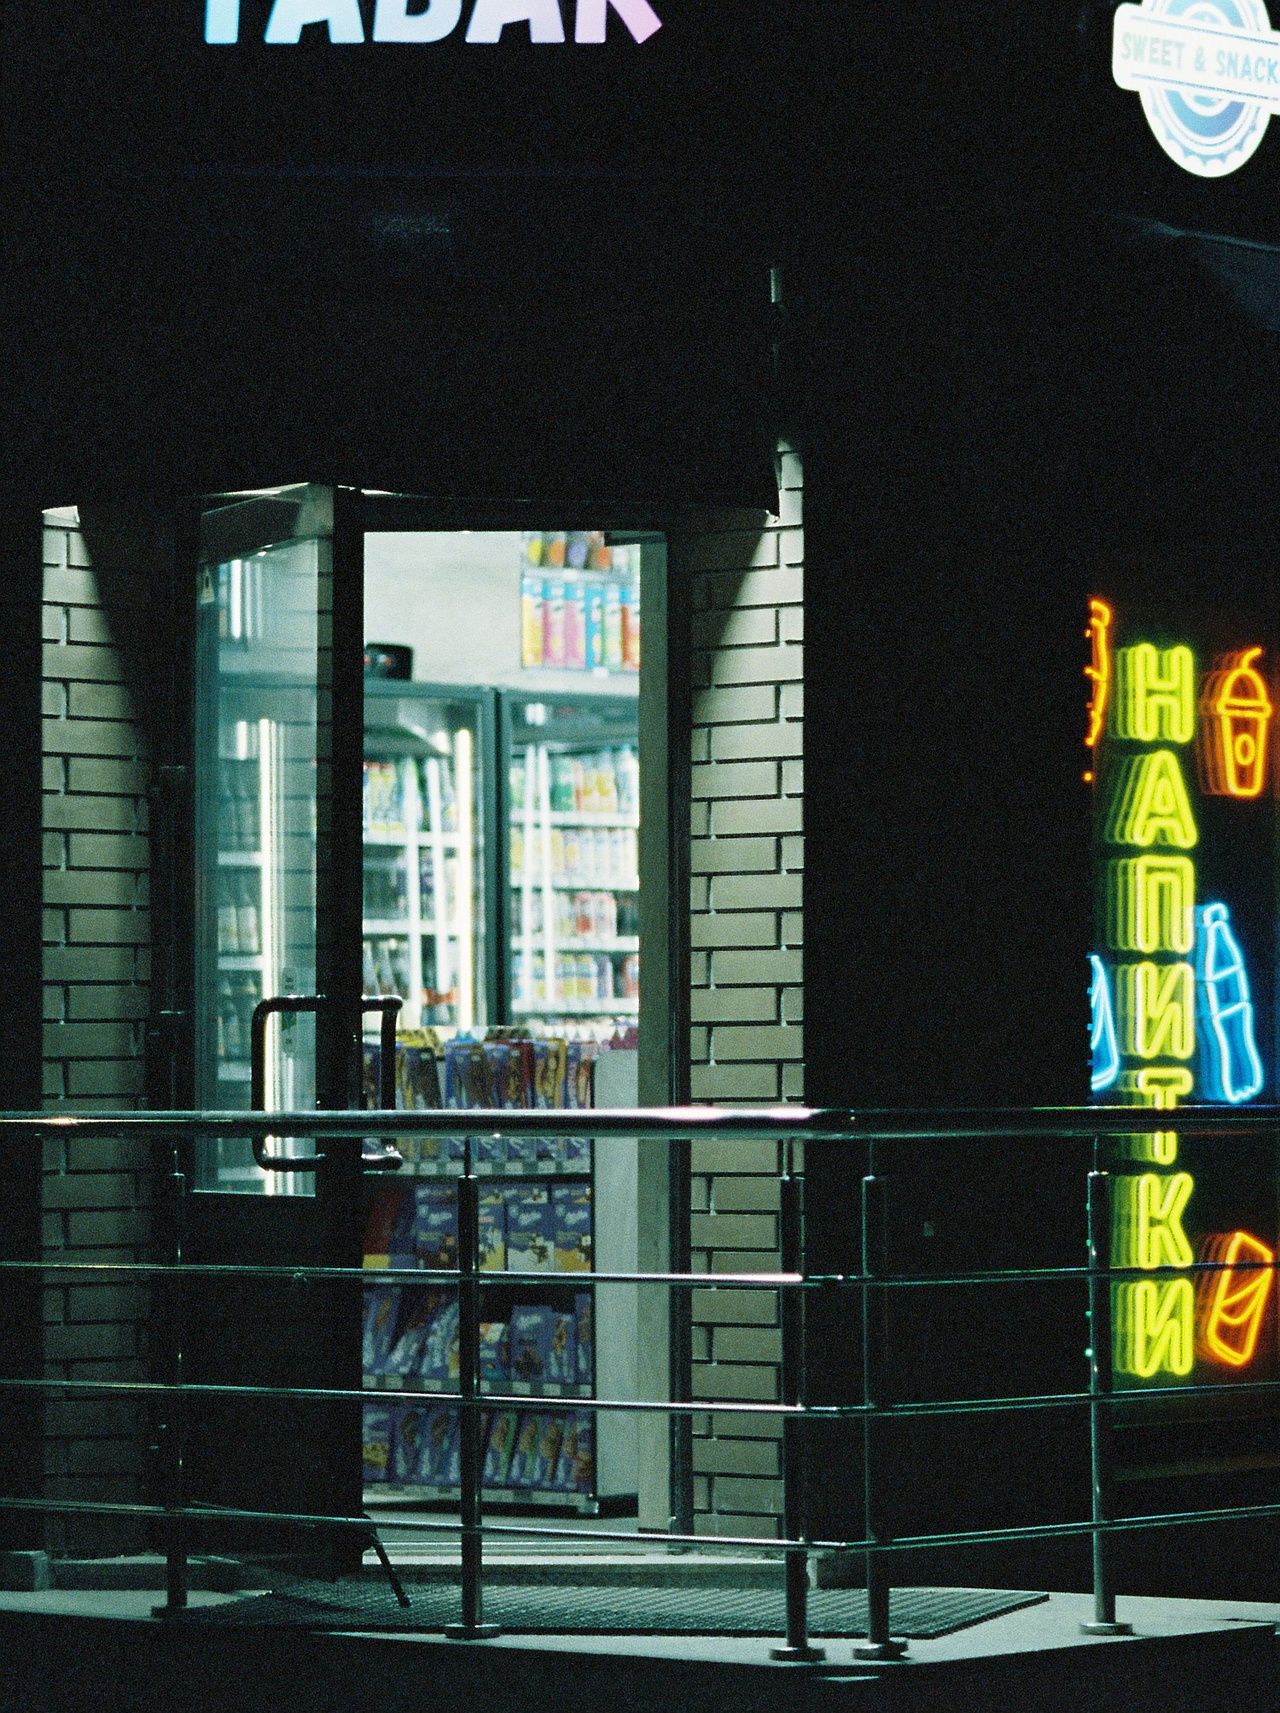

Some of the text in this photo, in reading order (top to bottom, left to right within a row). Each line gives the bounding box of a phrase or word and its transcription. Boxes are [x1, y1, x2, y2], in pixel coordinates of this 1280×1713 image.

[1121, 31, 1186, 69] SWEET
[1193, 46, 1206, 73] &
[1126, 641, 1198, 1379] НАПИТКИ
